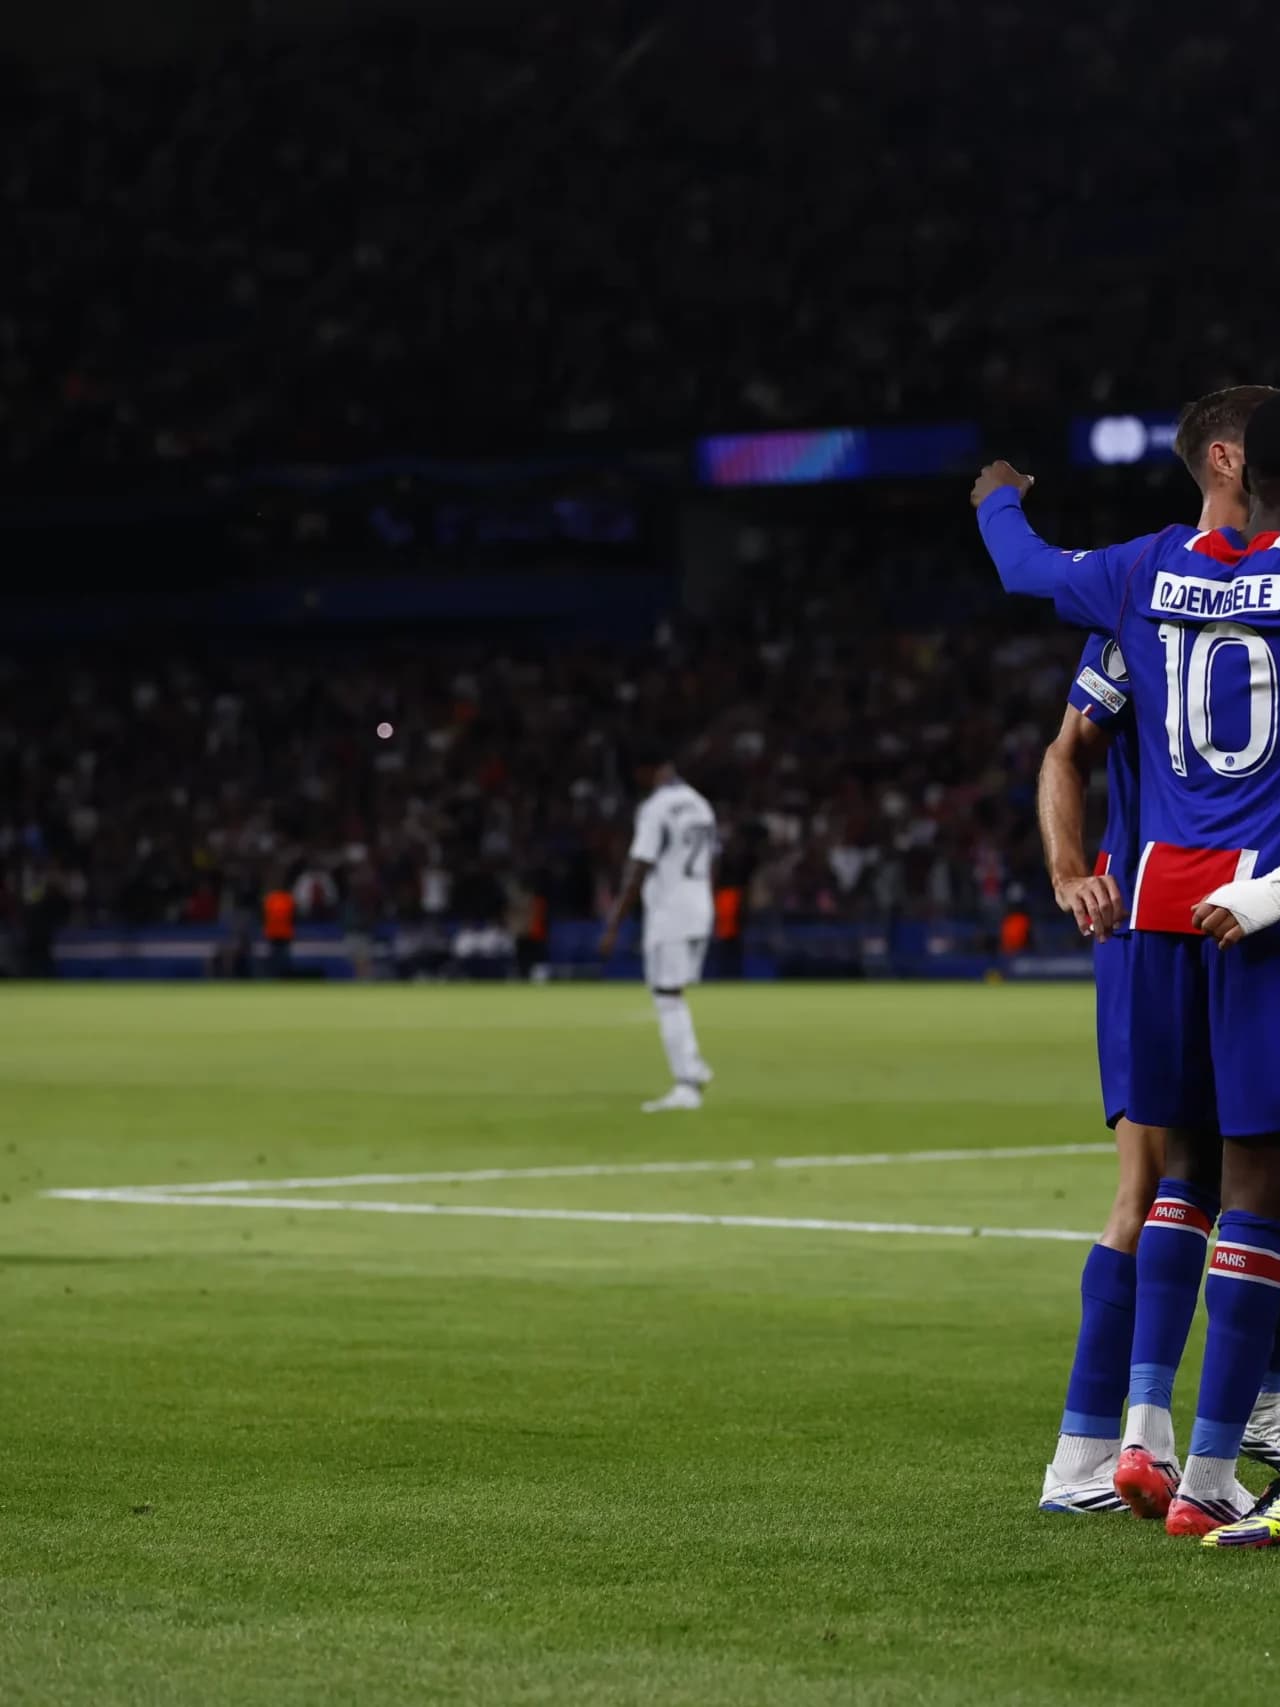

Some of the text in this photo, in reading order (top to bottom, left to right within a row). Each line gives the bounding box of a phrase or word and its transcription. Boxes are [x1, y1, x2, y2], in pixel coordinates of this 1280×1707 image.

[1159, 577, 1274, 616] O.DEMBÉLÉ
[1158, 619, 1280, 779] 10
[1154, 1206, 1186, 1220] PARIS
[1215, 1251, 1247, 1268] PARIS
